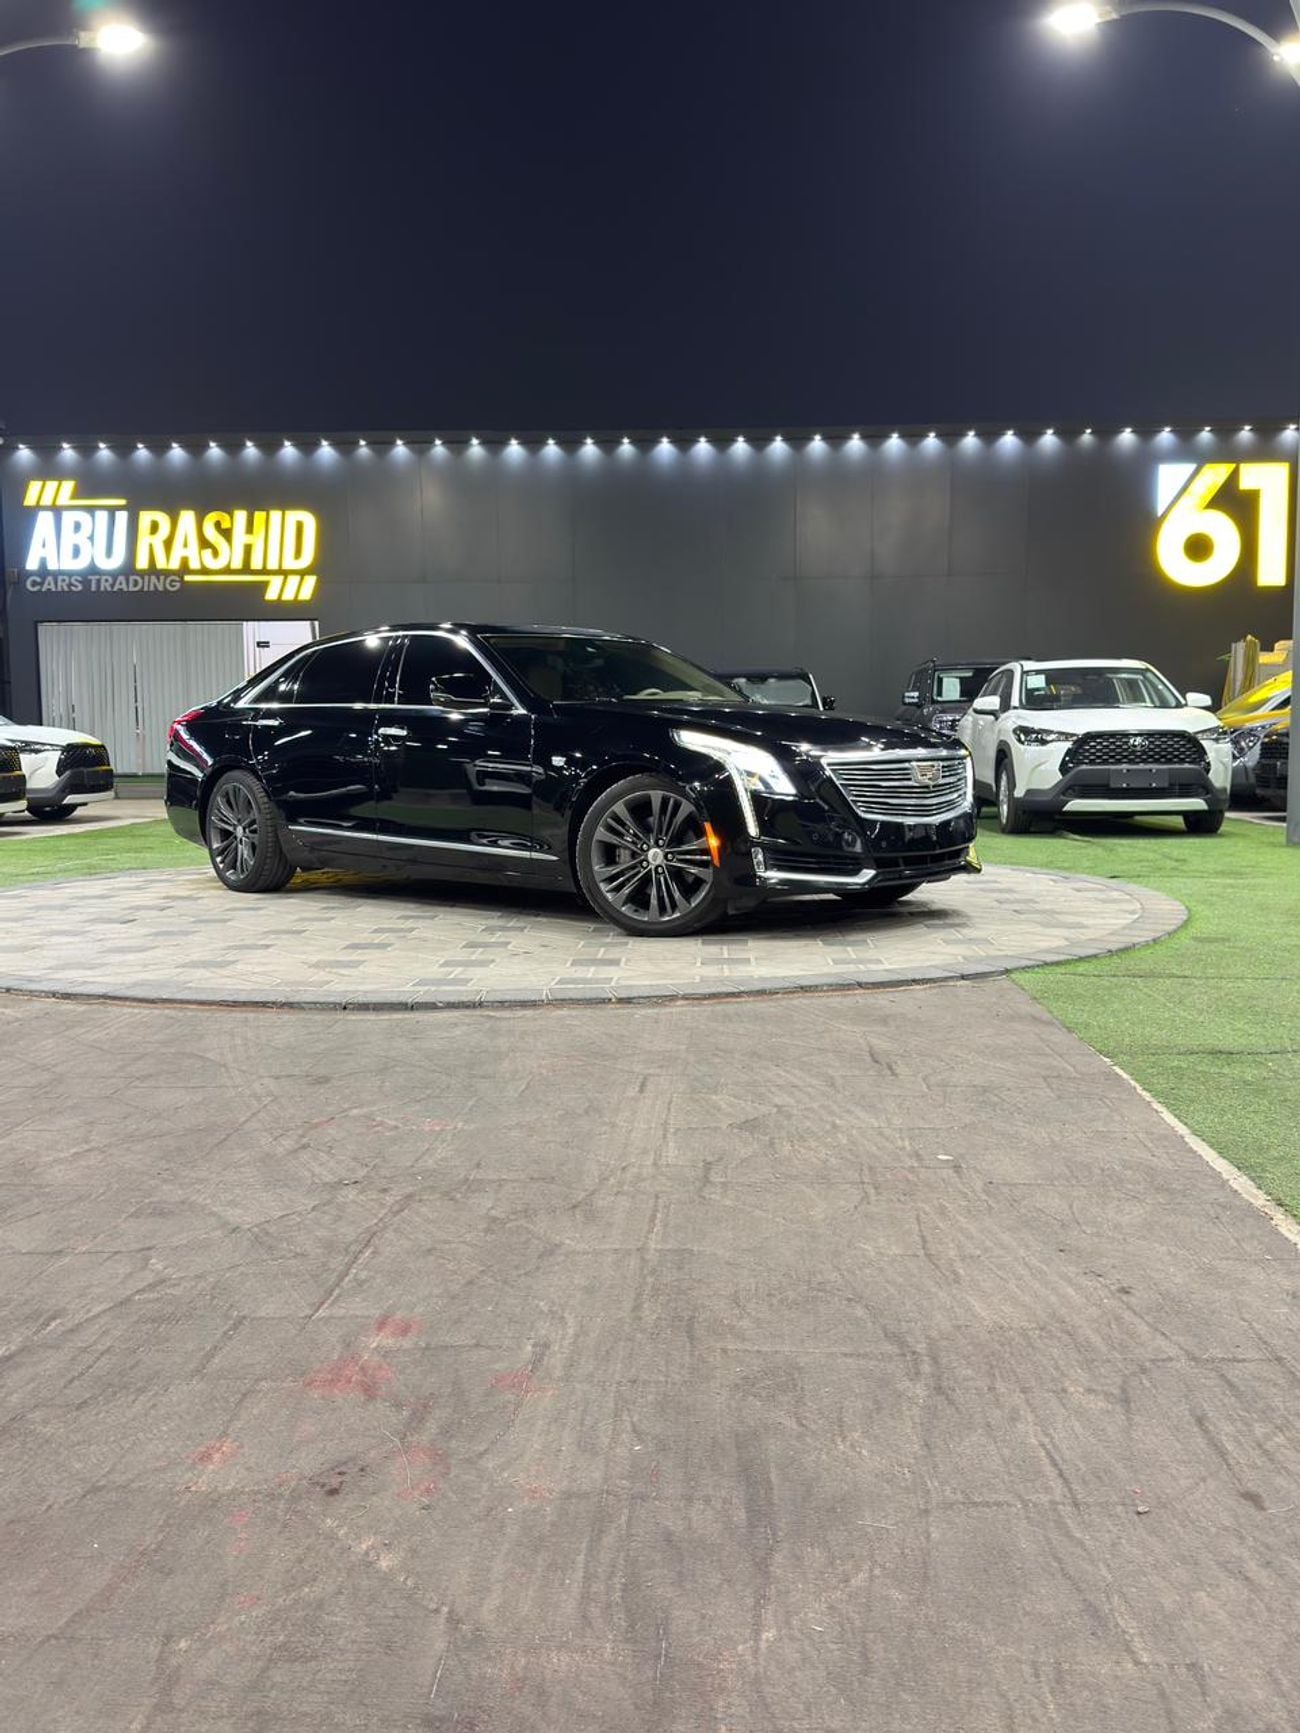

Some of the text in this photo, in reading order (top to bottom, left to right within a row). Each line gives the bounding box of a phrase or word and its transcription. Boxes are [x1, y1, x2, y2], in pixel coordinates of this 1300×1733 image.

[25, 510, 317, 570] ABU RASHID
[1156, 462, 1290, 588] 61
[25, 575, 181, 592] CARS TRADING
